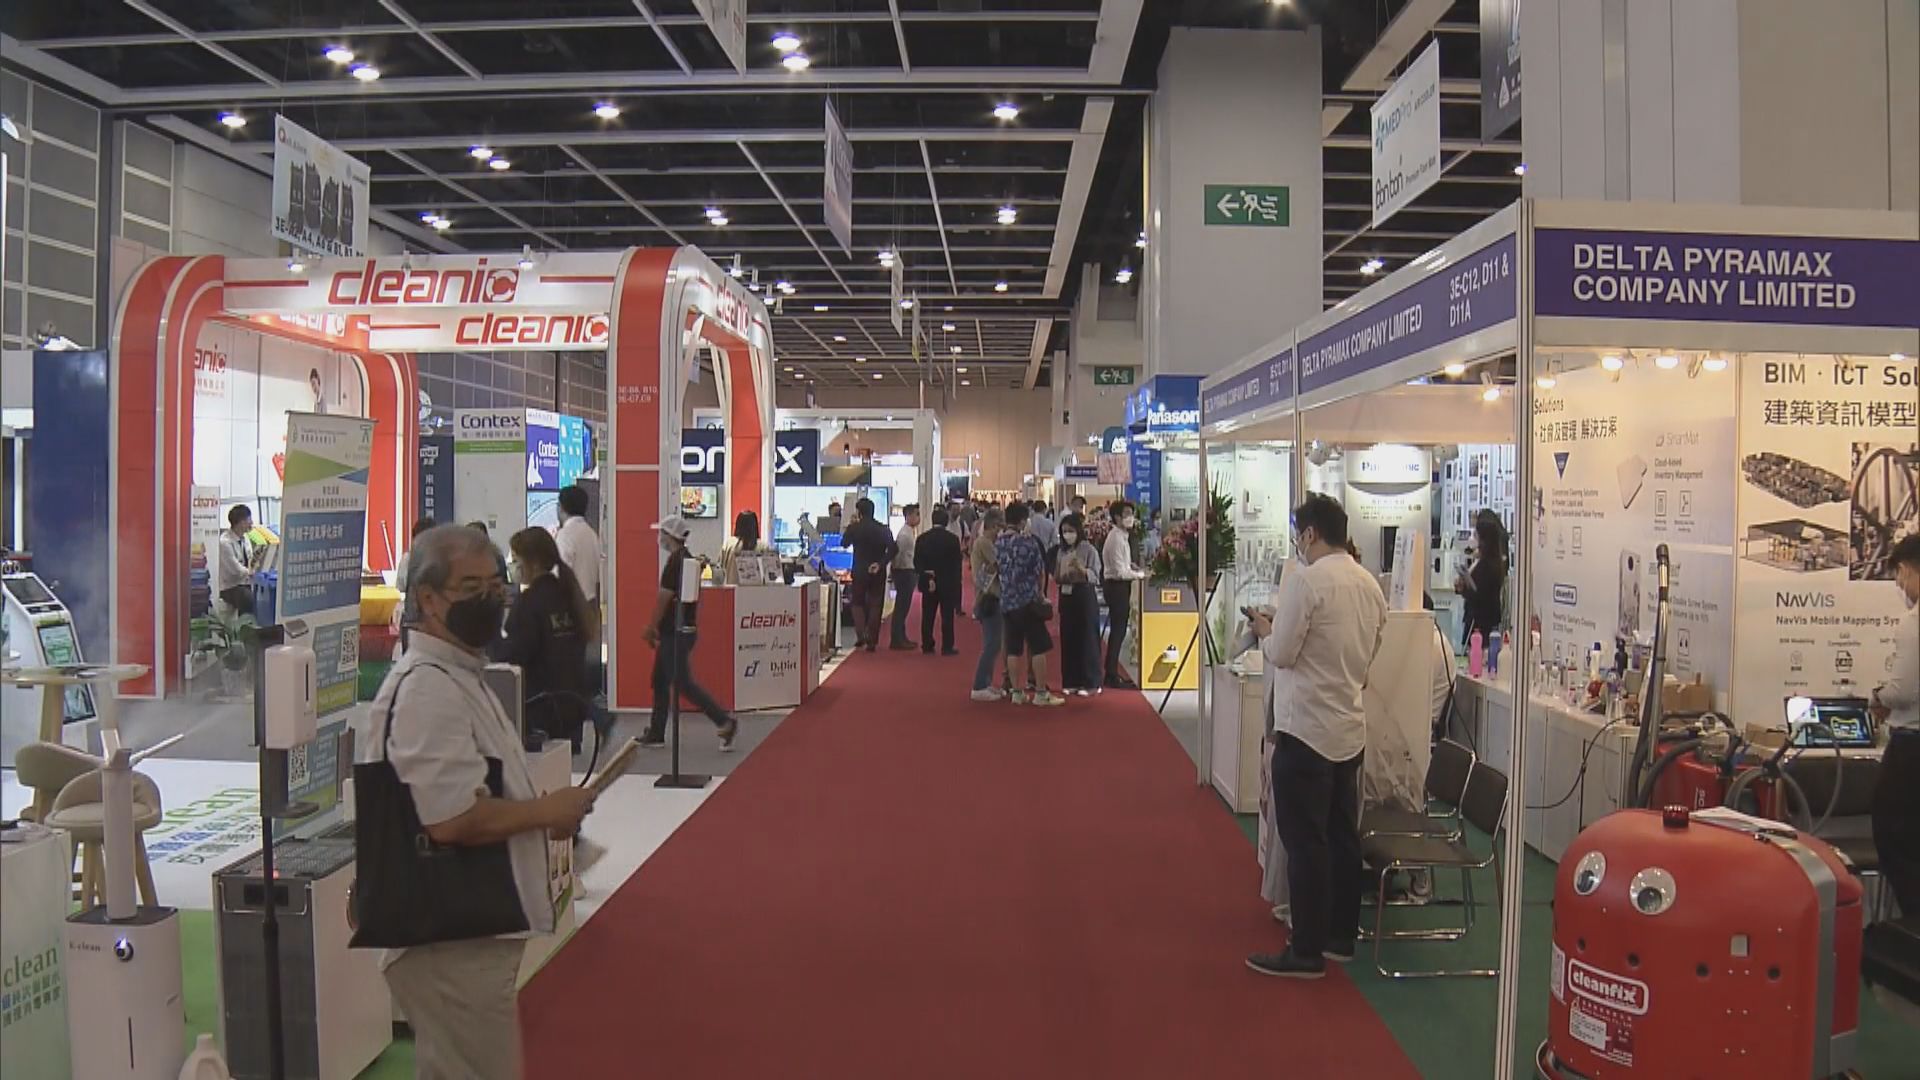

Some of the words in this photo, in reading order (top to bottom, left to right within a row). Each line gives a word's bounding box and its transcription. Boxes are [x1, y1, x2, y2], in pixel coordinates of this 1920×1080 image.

[1450, 267, 1481, 300] 3E-C12,
[1482, 255, 1499, 286] D11
[1502, 252, 1509, 278] &
[1574, 244, 1674, 271] DELTA
[1684, 248, 1832, 277] PYRAMAX
[1573, 275, 1729, 304] COMPANY
[1739, 281, 1856, 308] LIMITED
[1450, 304, 1471, 328] D11A
[1302, 354, 1320, 378] DELTA
[1320, 336, 1350, 368] PYRAMAX
[1350, 322, 1388, 357] COMPANY
[1388, 303, 1422, 344] LIMITED
[1764, 362, 1806, 384] BIM
[1834, 365, 1868, 386] ICT
[461, 414, 521, 430] Contex
[1581, 416, 1617, 439] 解決方案
[1764, 398, 1917, 427] 建築資訊模型
[1776, 615, 1808, 625] NavVis
[1810, 615, 1840, 625] Mobile
[1842, 615, 1881, 627] Mapping
[3, 946, 58, 988] clean
[1572, 970, 1637, 1004] cleanfix
